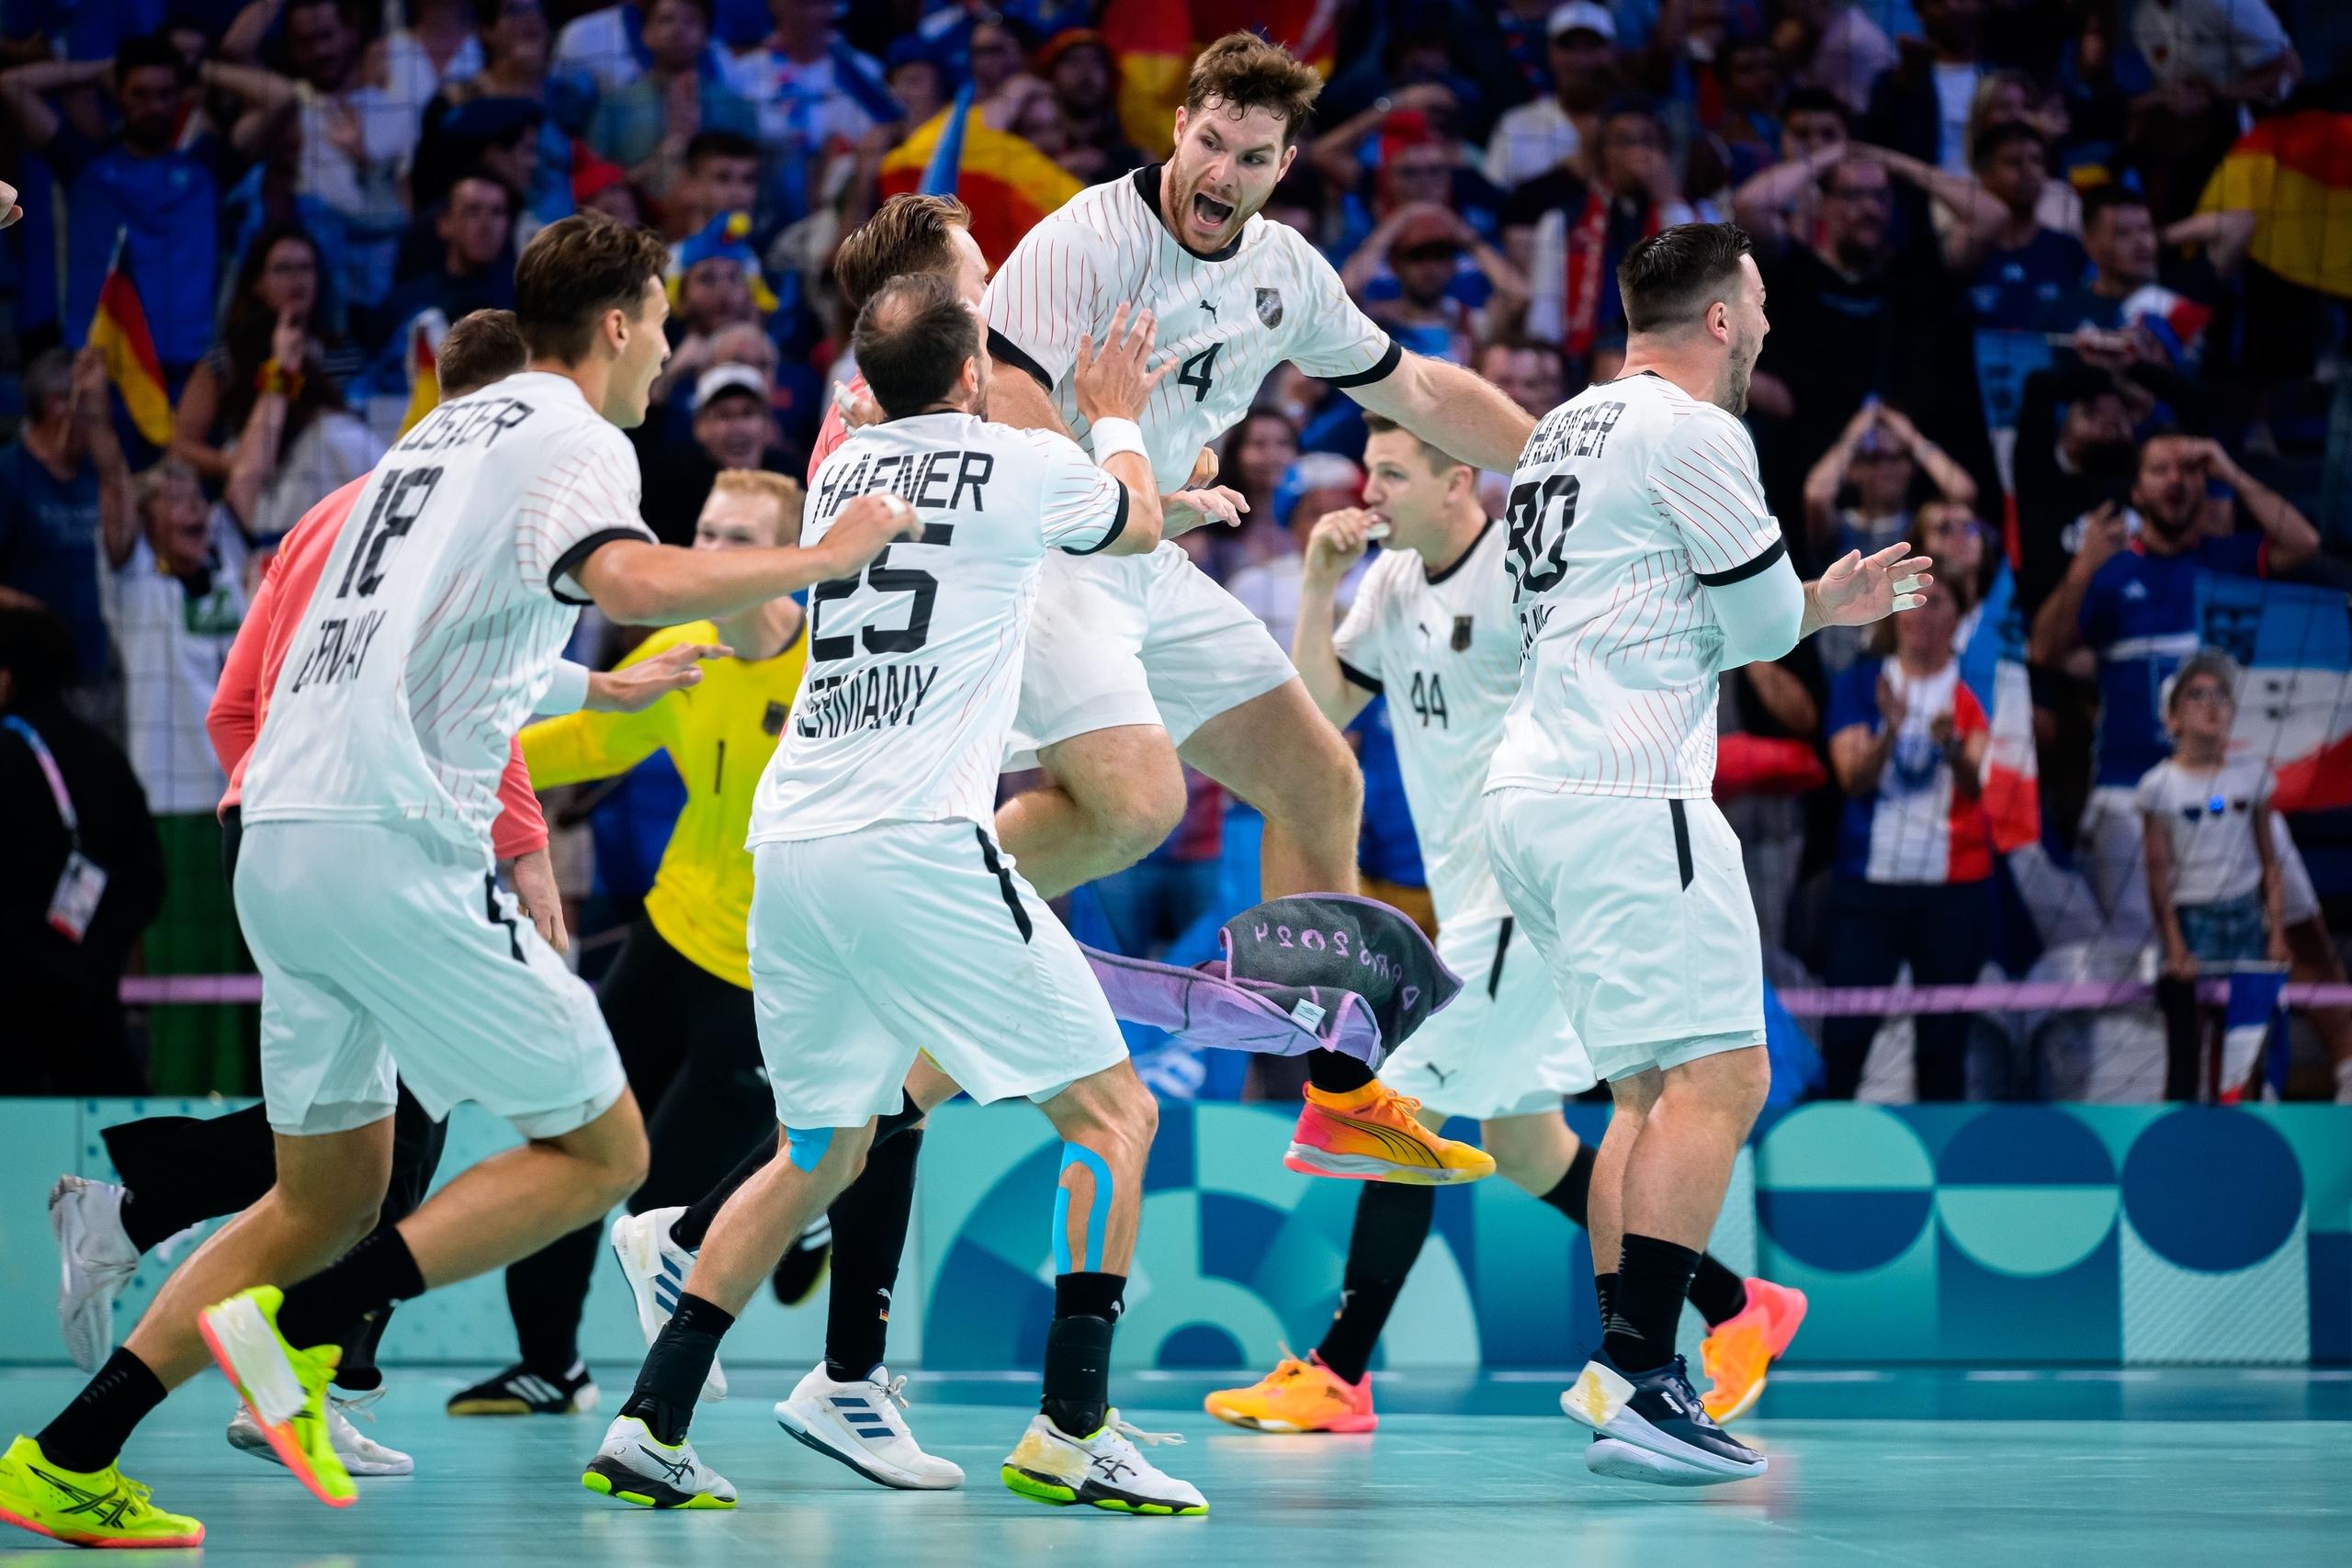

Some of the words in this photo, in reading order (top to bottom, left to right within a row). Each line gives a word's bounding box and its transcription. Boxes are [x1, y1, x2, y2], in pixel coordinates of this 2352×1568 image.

[1178, 342, 1225, 402] 4
[811, 450, 995, 524] HÄFNER
[1504, 474, 1581, 604] 80
[811, 522, 956, 663] 25
[795, 664, 940, 739] ERMANY
[1410, 671, 1449, 730] 44
[714, 739, 726, 795] 1
